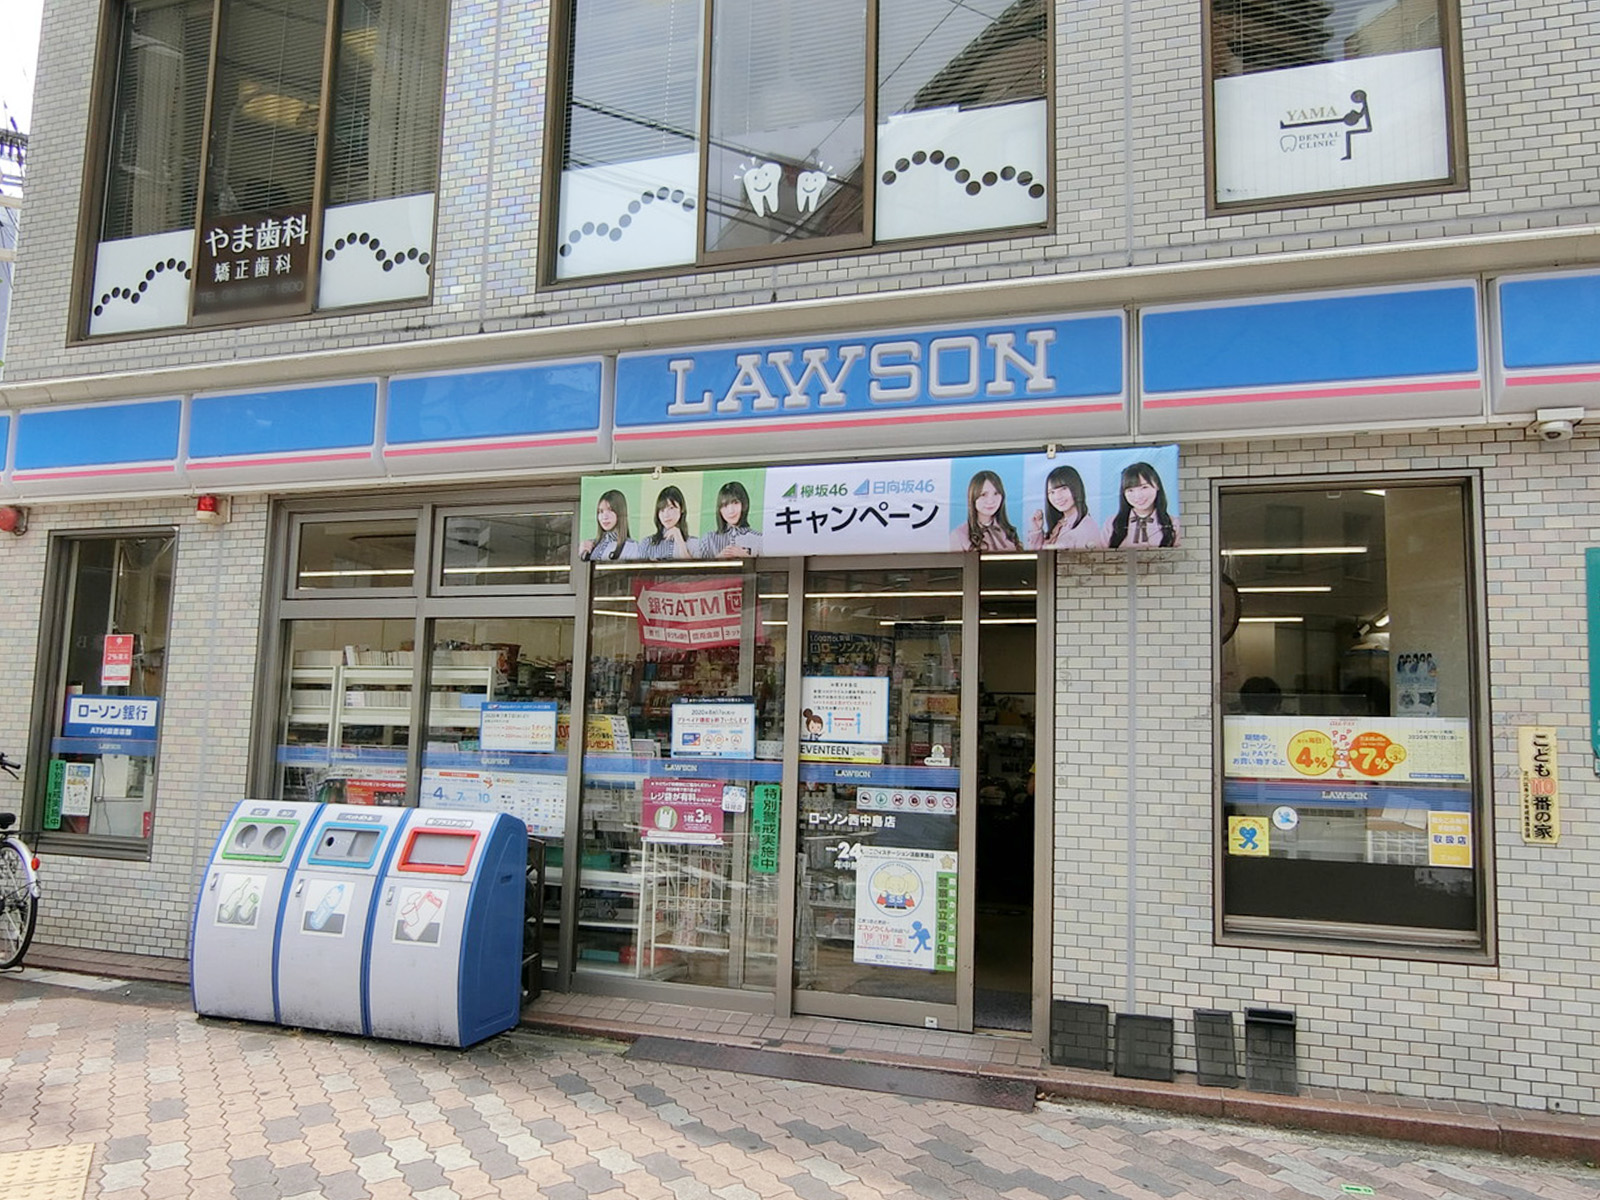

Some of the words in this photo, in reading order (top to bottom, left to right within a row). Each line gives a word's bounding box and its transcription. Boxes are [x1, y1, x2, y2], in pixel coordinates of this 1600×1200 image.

[1286, 106, 1338, 121] YAMA
[1299, 131, 1341, 142] DENTAL
[1299, 139, 1337, 149] CLINIC
[205, 214, 309, 257] やま歯科
[214, 253, 291, 282] 矯正歯科
[667, 329, 1057, 416] LAWSON
[801, 483, 848, 499] 欅坂46
[873, 479, 935, 495] 日向坂46
[775, 501, 939, 535] キャンペーン
[78, 704, 148, 721] ローソン銀行
[664, 763, 698, 772] LAWSON
[1296, 747, 1328, 768] 4%
[1359, 747, 1389, 770] 7%
[834, 769, 872, 778] LAWSON
[1321, 790, 1368, 800] LAWSON
[1530, 734, 1556, 839] こども110番の家
[760, 788, 778, 869] 特別警戒実施中
[809, 813, 896, 829] ローソン西中島店
